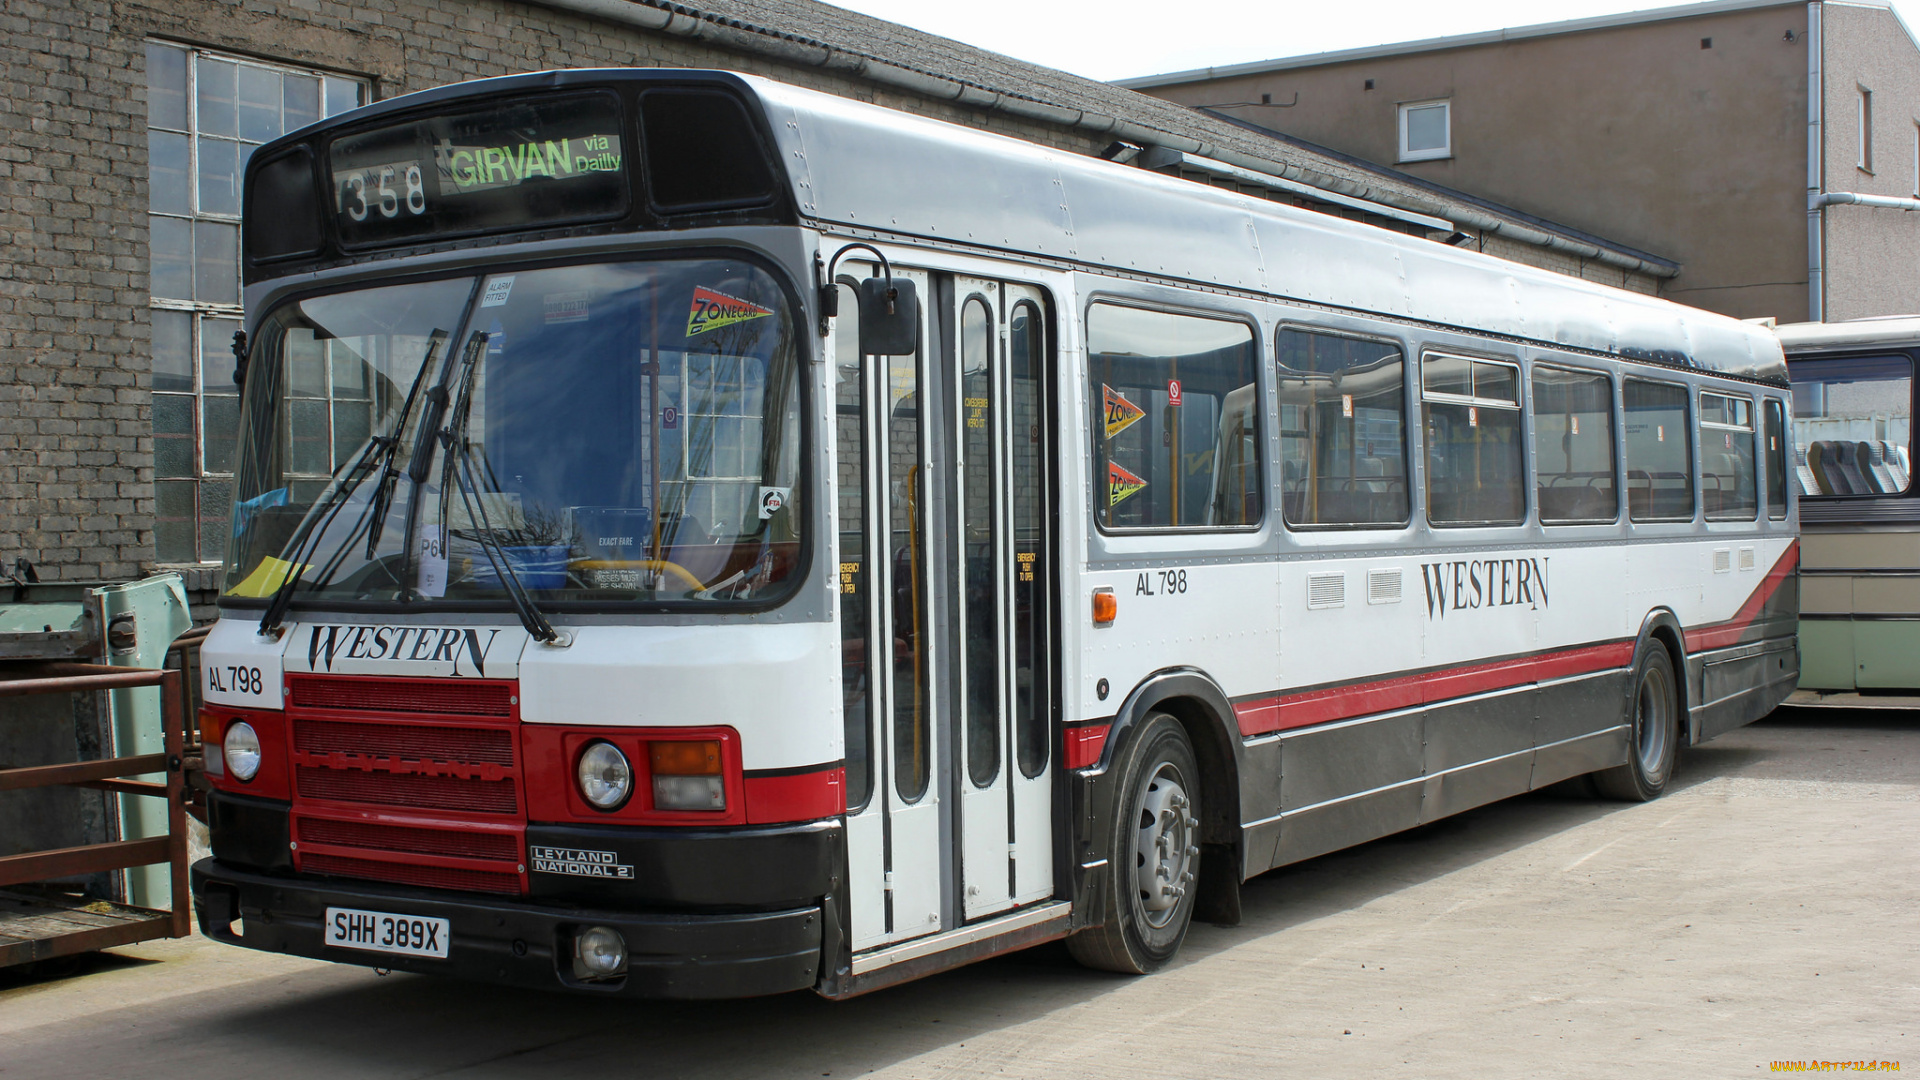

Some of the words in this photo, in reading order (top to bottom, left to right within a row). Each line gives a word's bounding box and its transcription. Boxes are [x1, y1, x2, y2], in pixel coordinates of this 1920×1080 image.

[584, 134, 609, 151] via
[575, 153, 621, 173] Dailly
[349, 165, 426, 222] 358
[451, 138, 572, 187] GIRVAN
[485, 292, 507, 302] FITTED
[489, 282, 512, 292] ALARM
[690, 298, 758, 325] ZONECARD
[599, 537, 618, 546] EXACT
[618, 537, 634, 546] FARE
[594, 574, 620, 582] PASSES
[620, 573, 639, 582] MUST
[1136, 572, 1154, 596] AL
[1158, 569, 1187, 594] 798
[1420, 557, 1550, 622] WESTERN
[308, 625, 502, 678] WESTERN
[209, 666, 227, 693] AL
[228, 665, 263, 695] 798
[535, 848, 613, 864] LEYLAND
[535, 861, 613, 876] NATIONAL
[617, 867, 629, 877] 2
[335, 912, 376, 944] SHH
[382, 917, 440, 951] 389X
